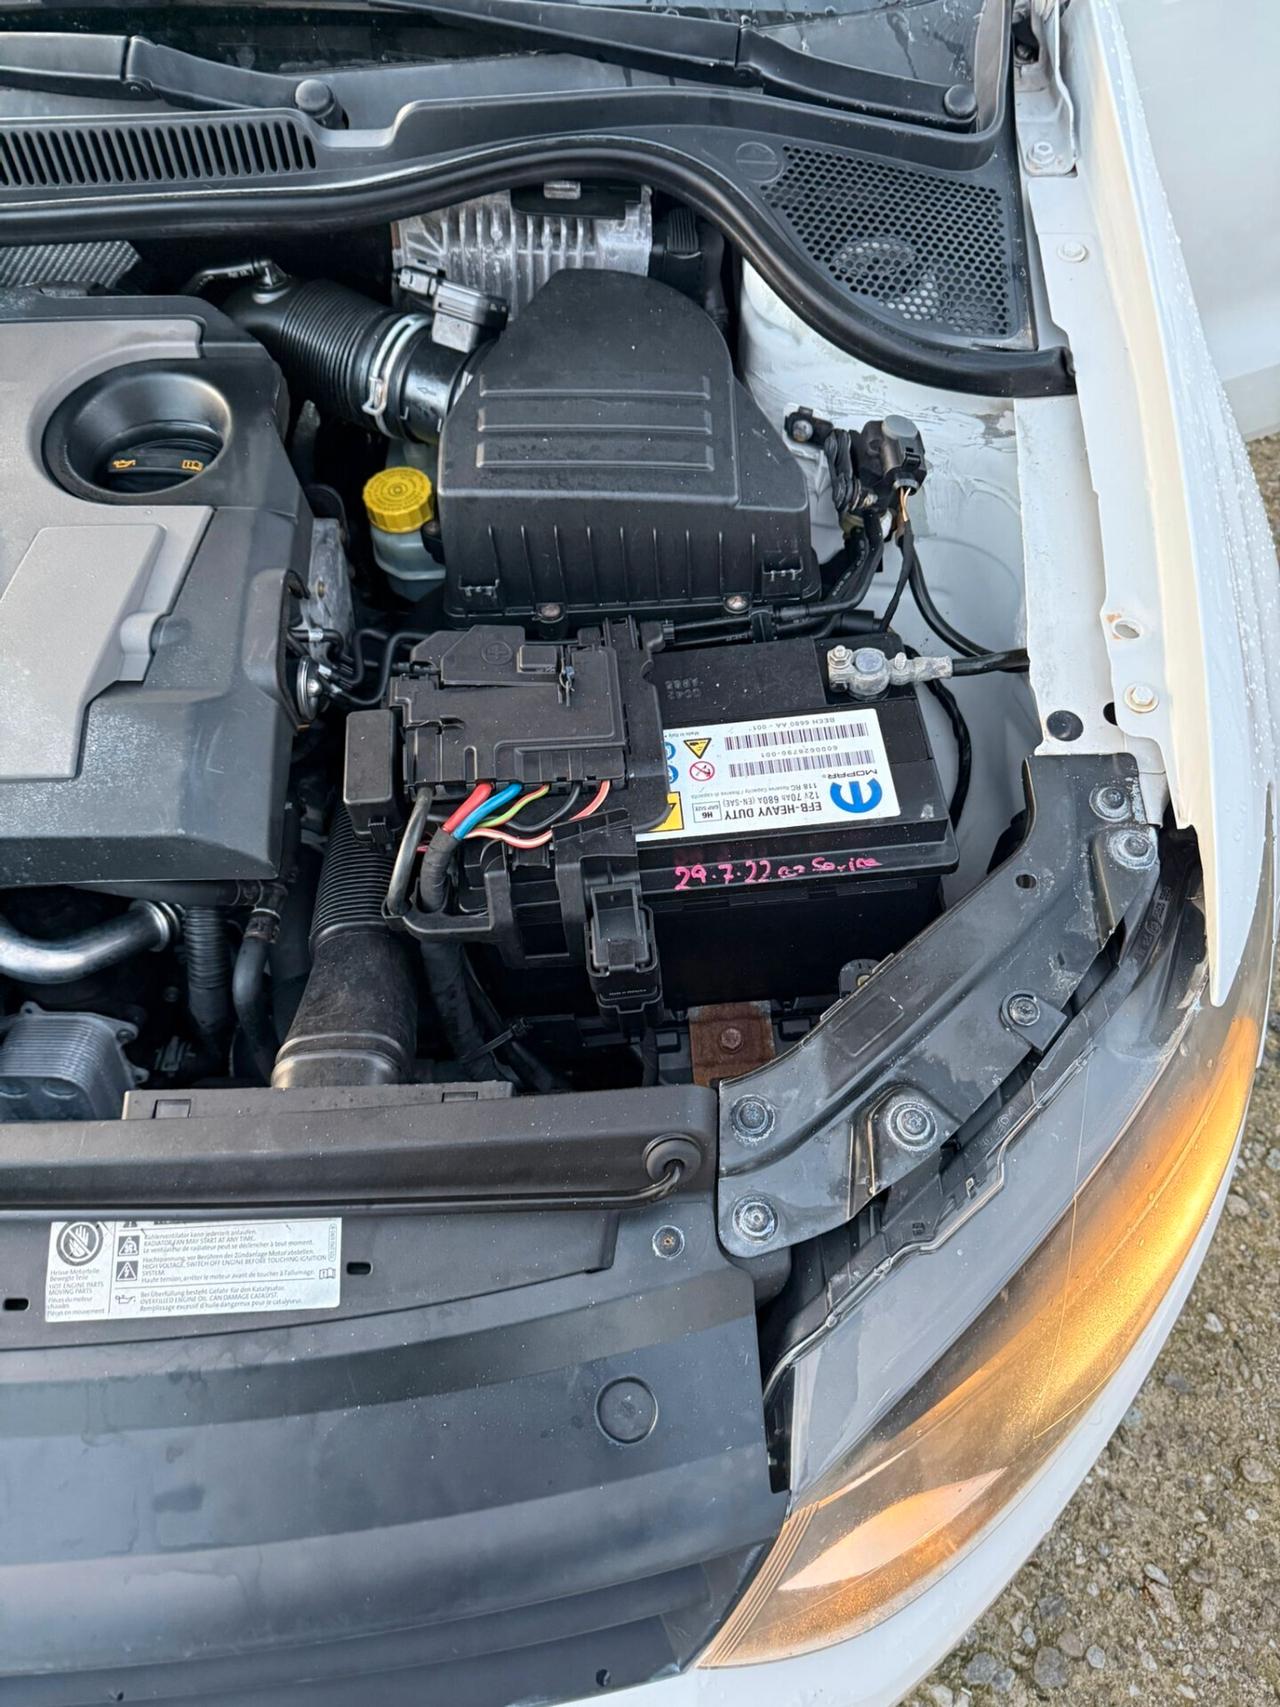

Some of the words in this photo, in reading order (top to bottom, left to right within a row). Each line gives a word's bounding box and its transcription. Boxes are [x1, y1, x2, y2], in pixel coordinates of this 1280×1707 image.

[722, 797, 756, 808] (EN-SAE)
[701, 811, 714, 819] H6
[724, 808, 754, 821] DUTY
[758, 801, 823, 817] EFB-HEAVY
